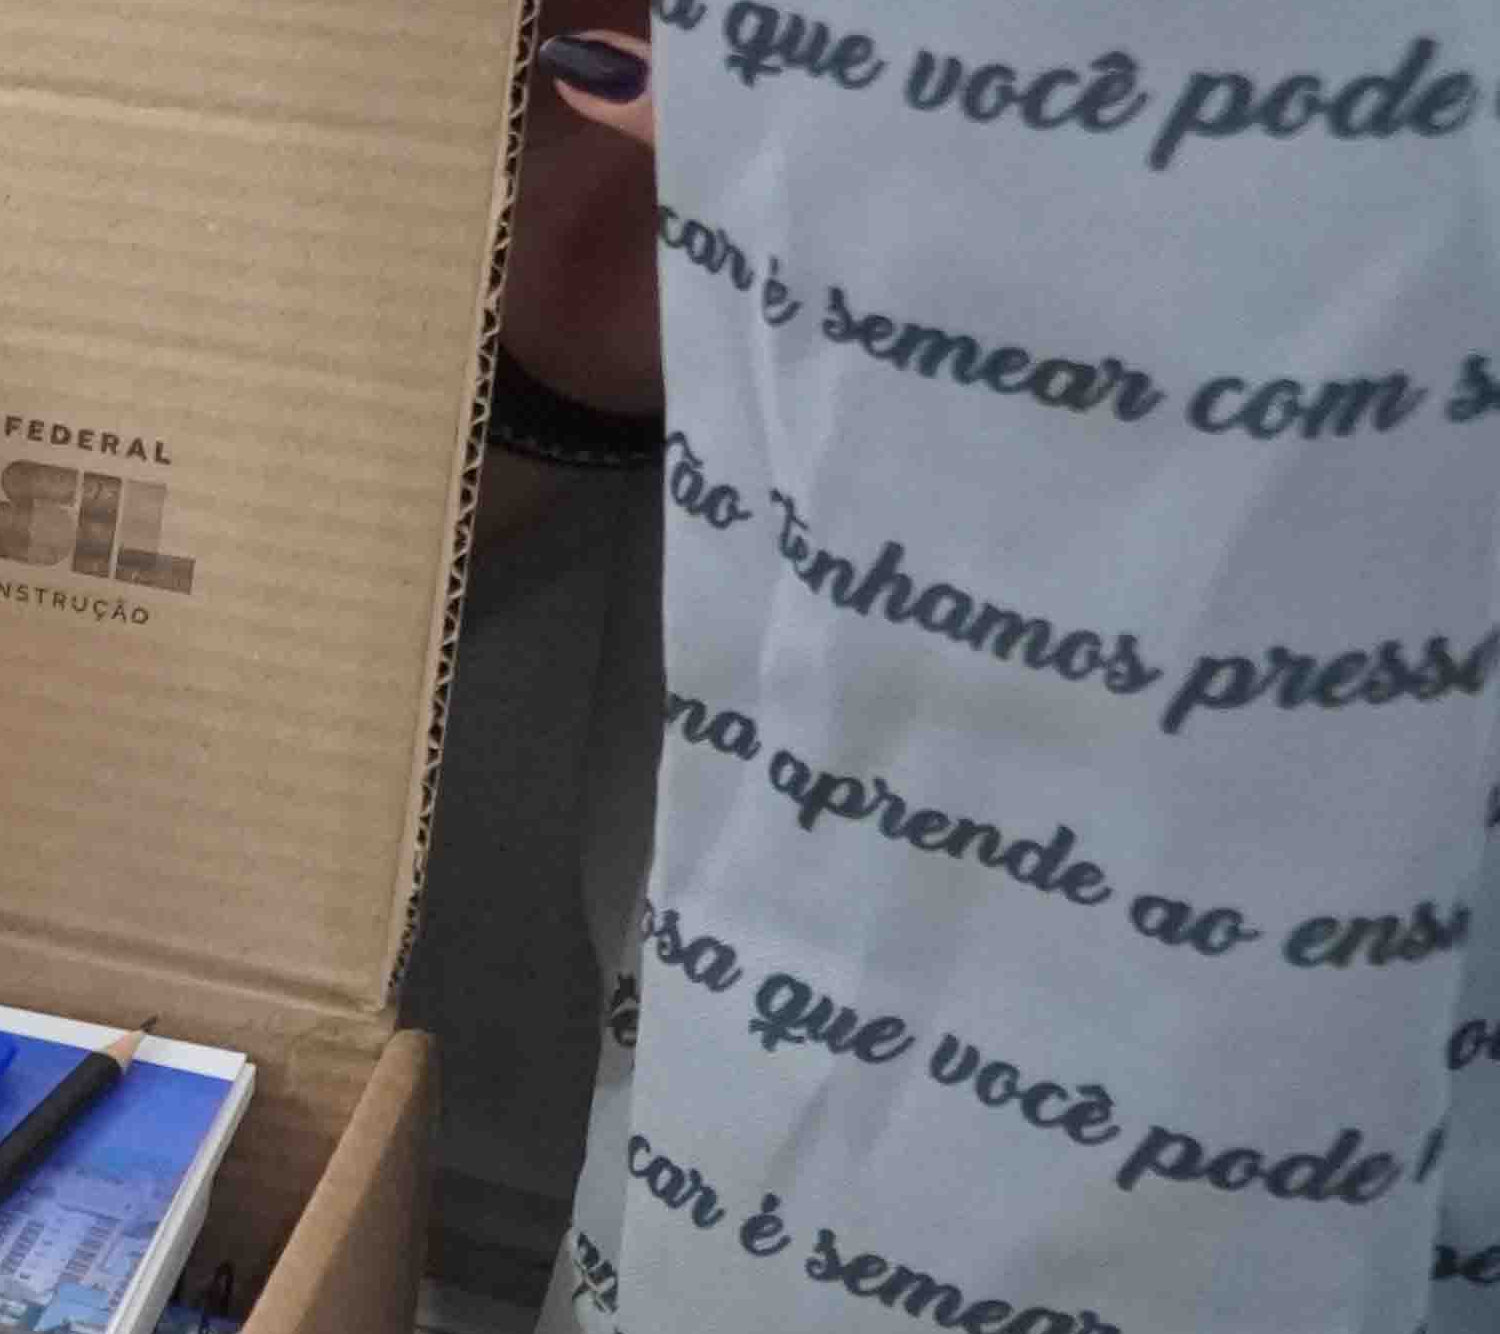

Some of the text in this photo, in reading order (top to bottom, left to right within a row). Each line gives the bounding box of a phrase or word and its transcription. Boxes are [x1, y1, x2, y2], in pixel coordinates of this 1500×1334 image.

[905, 49, 1150, 133] você
[1148, 36, 1479, 172] pode
[4, 413, 174, 467] FEDERAL
[822, 285, 1165, 424] semear
[1186, 375, 1427, 441] com
[768, 741, 1112, 906] aprende
[1128, 891, 1259, 955] ao
[749, 969, 915, 1053] que
[929, 1030, 1124, 1147] você
[1116, 1124, 1403, 1205] pode
